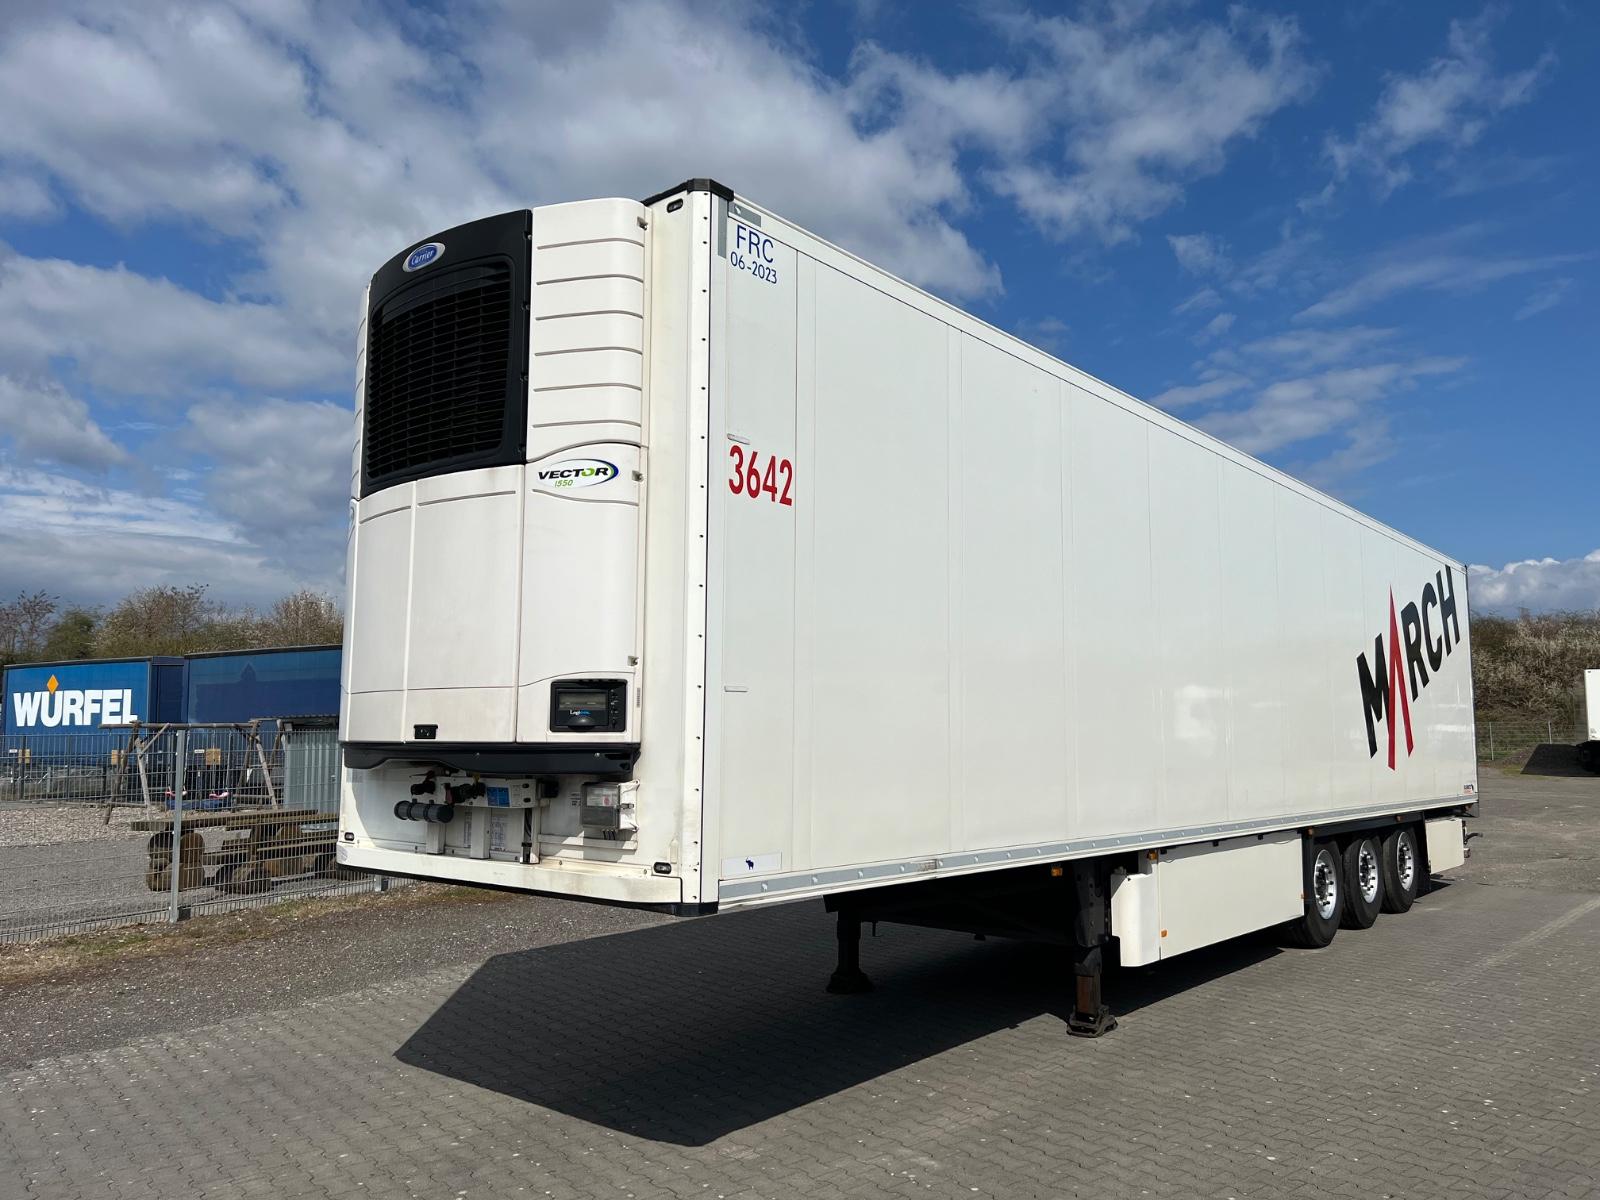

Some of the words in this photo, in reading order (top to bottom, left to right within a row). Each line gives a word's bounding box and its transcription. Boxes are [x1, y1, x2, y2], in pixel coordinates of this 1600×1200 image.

[411, 250, 435, 266] Carrier
[737, 224, 774, 263] FRC
[730, 251, 778, 284] 06-2023
[538, 467, 609, 480] VECTOR
[555, 480, 574, 488] 1550
[729, 445, 793, 507] 3642
[1356, 564, 1461, 771] MARCH
